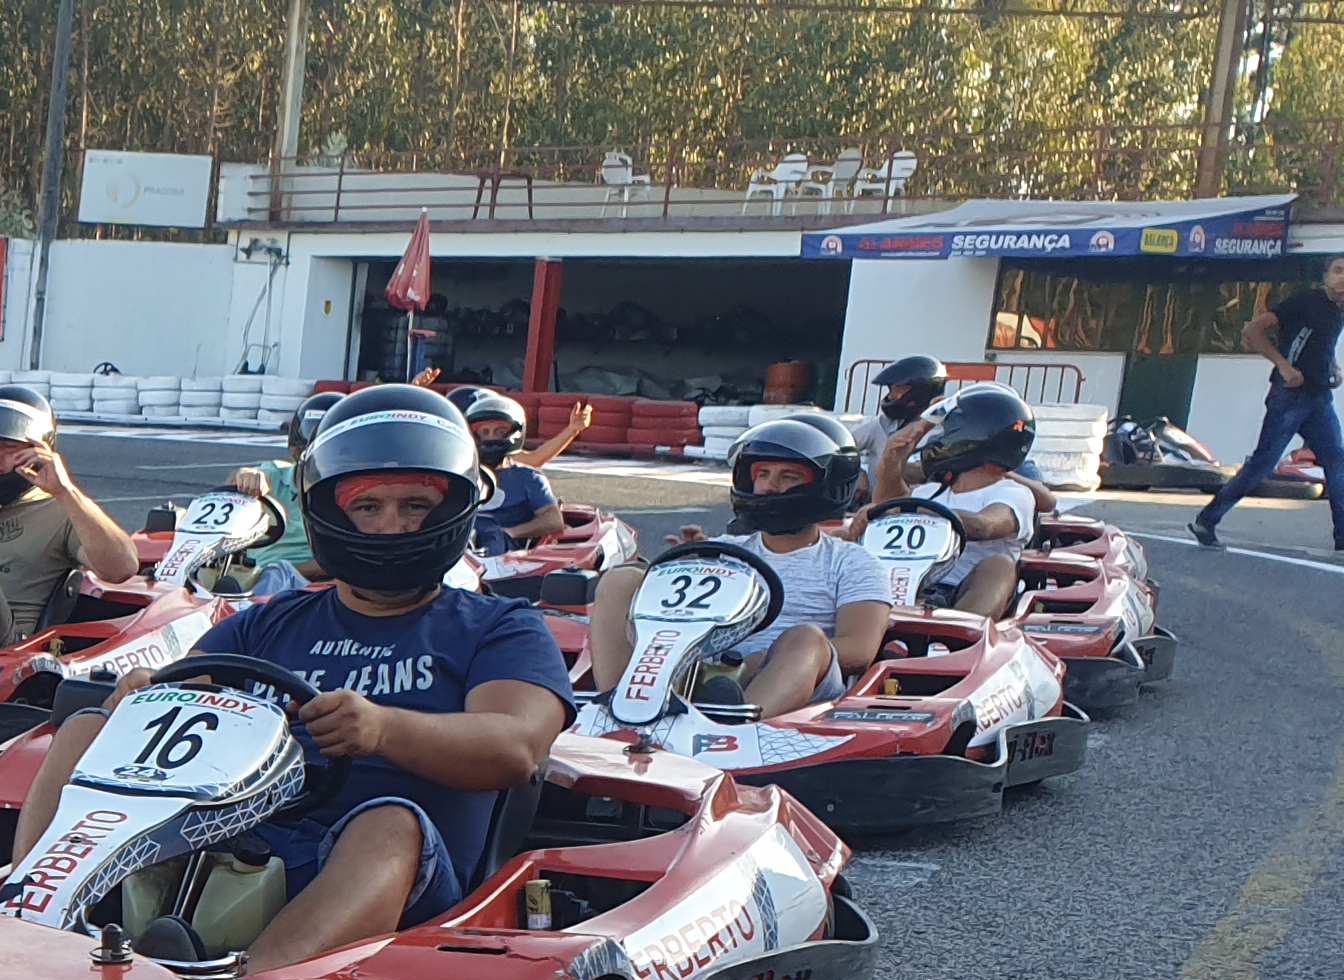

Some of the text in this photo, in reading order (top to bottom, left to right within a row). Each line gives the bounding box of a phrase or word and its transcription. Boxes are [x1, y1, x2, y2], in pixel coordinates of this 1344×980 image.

[952, 234, 1070, 252] SEGURANÇA
[1214, 238, 1282, 258] SEGURANÇA
[192, 502, 235, 526] 23
[883, 525, 927, 550] 20
[660, 574, 722, 610] 32
[625, 630, 682, 702] FERBERTO
[130, 691, 257, 713] EUROINDY
[133, 705, 219, 770] 16
